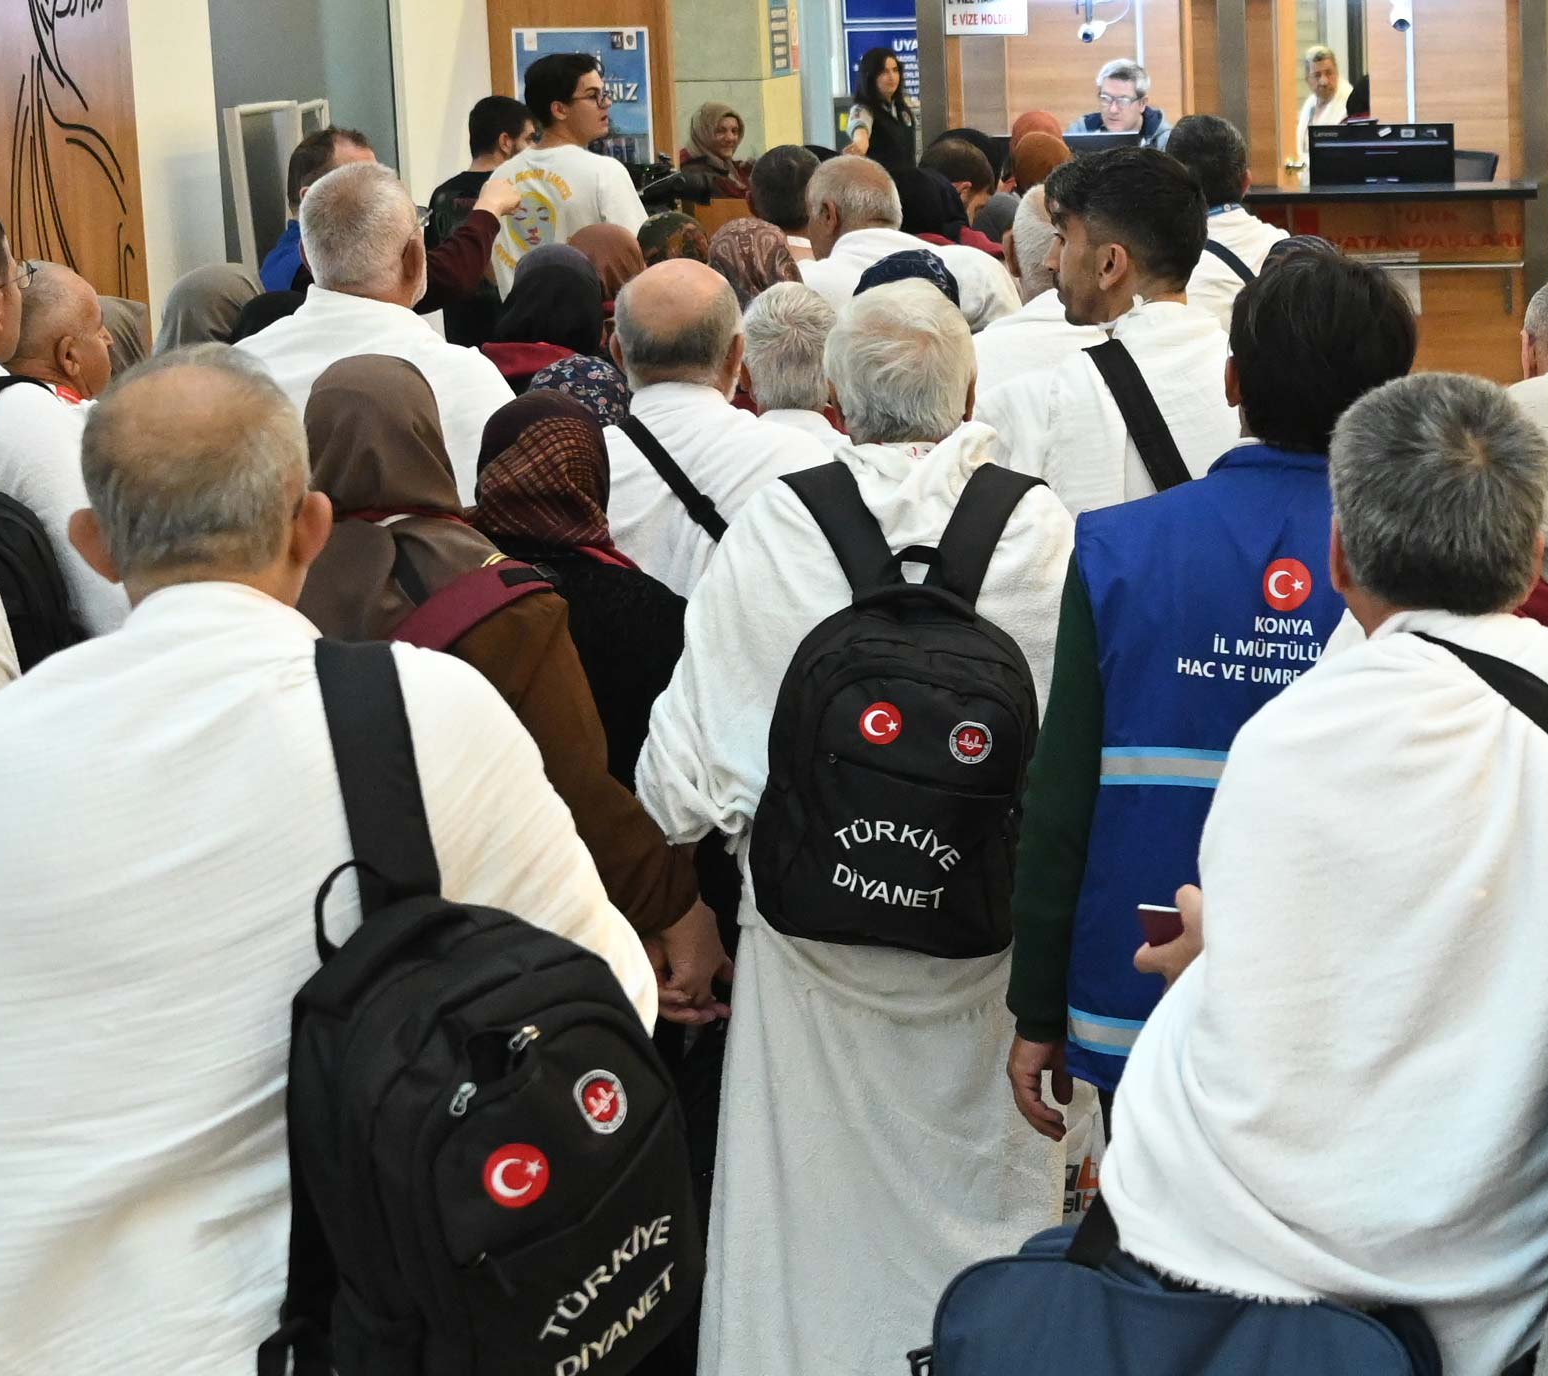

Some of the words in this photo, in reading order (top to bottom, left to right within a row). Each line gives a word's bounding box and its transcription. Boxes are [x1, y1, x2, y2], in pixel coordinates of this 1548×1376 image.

[1254, 616, 1313, 636] KONYA
[1213, 634, 1230, 654] İL
[1236, 639, 1322, 661] MÜFTÜLÜ
[1177, 658, 1215, 677] HAC
[1221, 664, 1245, 681] VE
[834, 819, 961, 871] TÜRKİYE
[833, 864, 944, 909] DİYANET
[539, 1215, 671, 1341] TÜRKİYE
